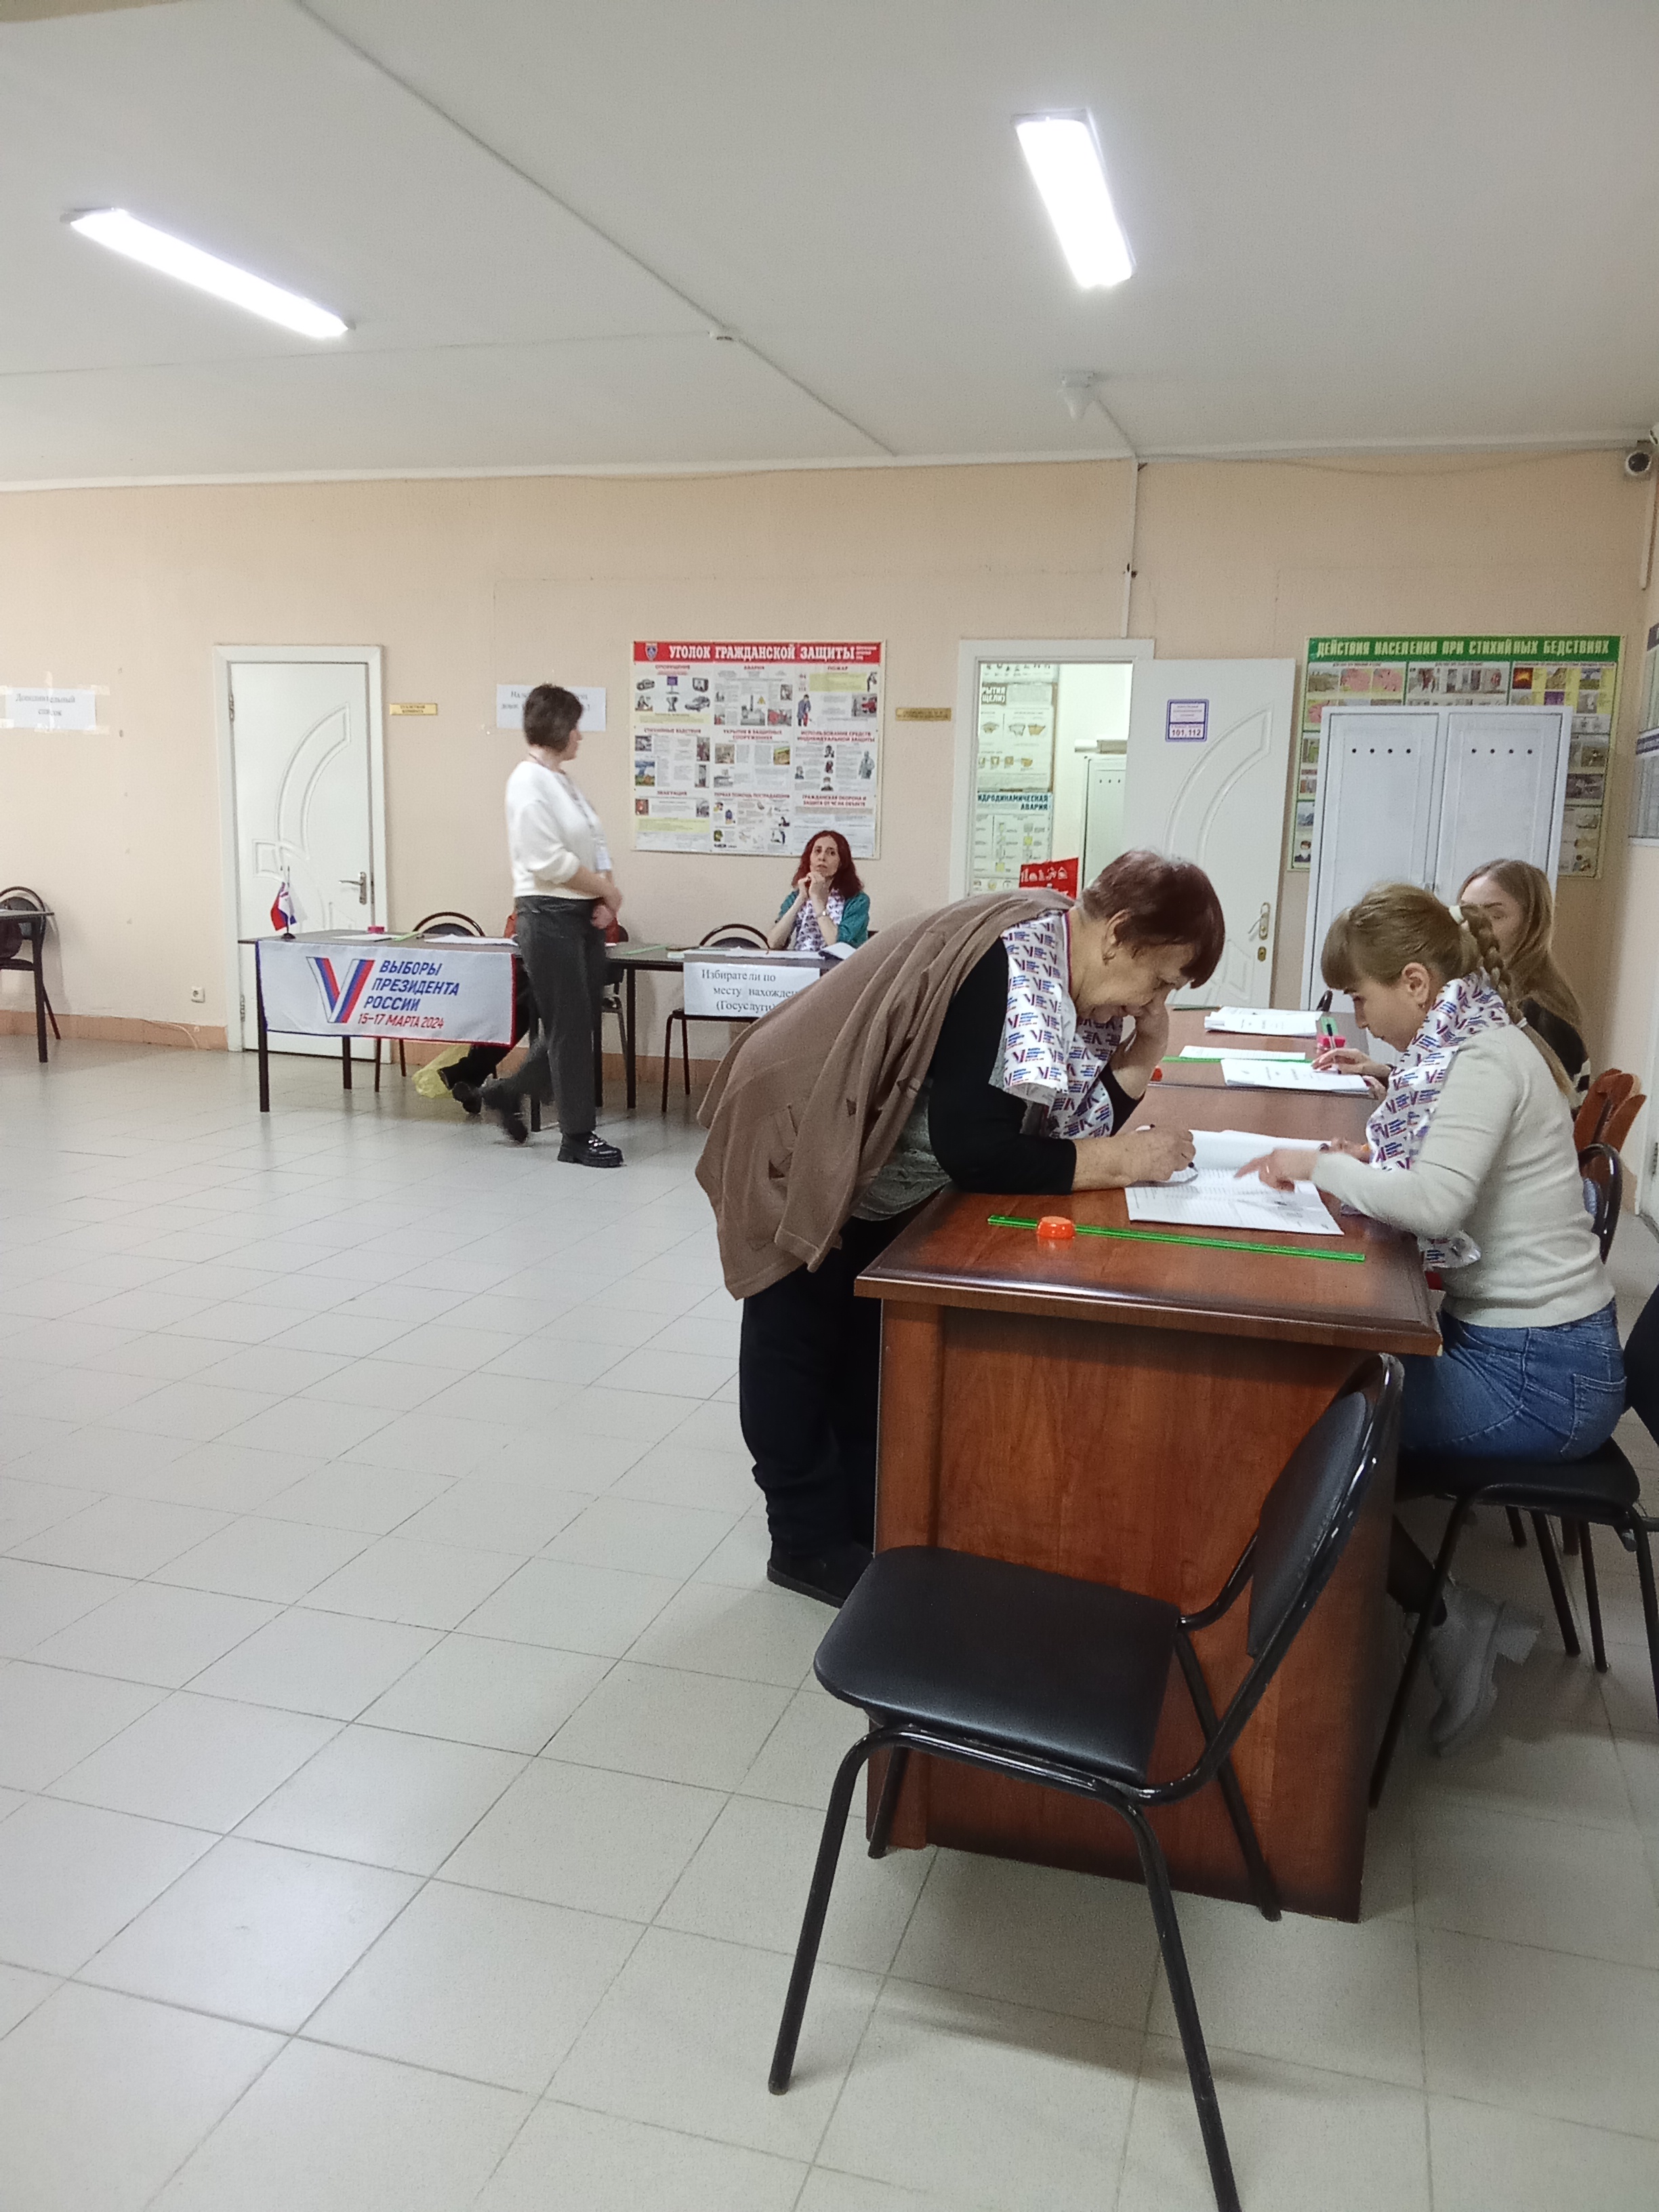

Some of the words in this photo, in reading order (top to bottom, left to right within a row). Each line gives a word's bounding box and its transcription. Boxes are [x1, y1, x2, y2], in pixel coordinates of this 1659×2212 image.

[669, 645, 711, 659] УГОЛОК
[715, 644, 796, 661] ГРАЖДАНСКОЙ
[800, 645, 855, 661] ЗАЩИТЫ
[1317, 639, 1370, 657] ДЕЙСТВИЯ
[1374, 641, 1437, 655] НАСЕЛЕНИЯ
[1442, 640, 1464, 655] ПРИ
[1469, 638, 1538, 655] СТИХИЙНЫХ
[1543, 640, 1610, 656] БЕДСТВИЯХ
[982, 695, 1006, 703] ЩЕЛИ)
[380, 960, 443, 976] ВЫБОРЫ
[701, 969, 760, 982] Избиратели
[764, 974, 776, 982] по
[371, 978, 459, 996] ПРЕЗИДЕНТА
[714, 987, 741, 997] месту
[364, 996, 421, 1011] РОССИИ
[385, 1015, 420, 1027] МАРТА
[421, 1017, 445, 1029] 2024
